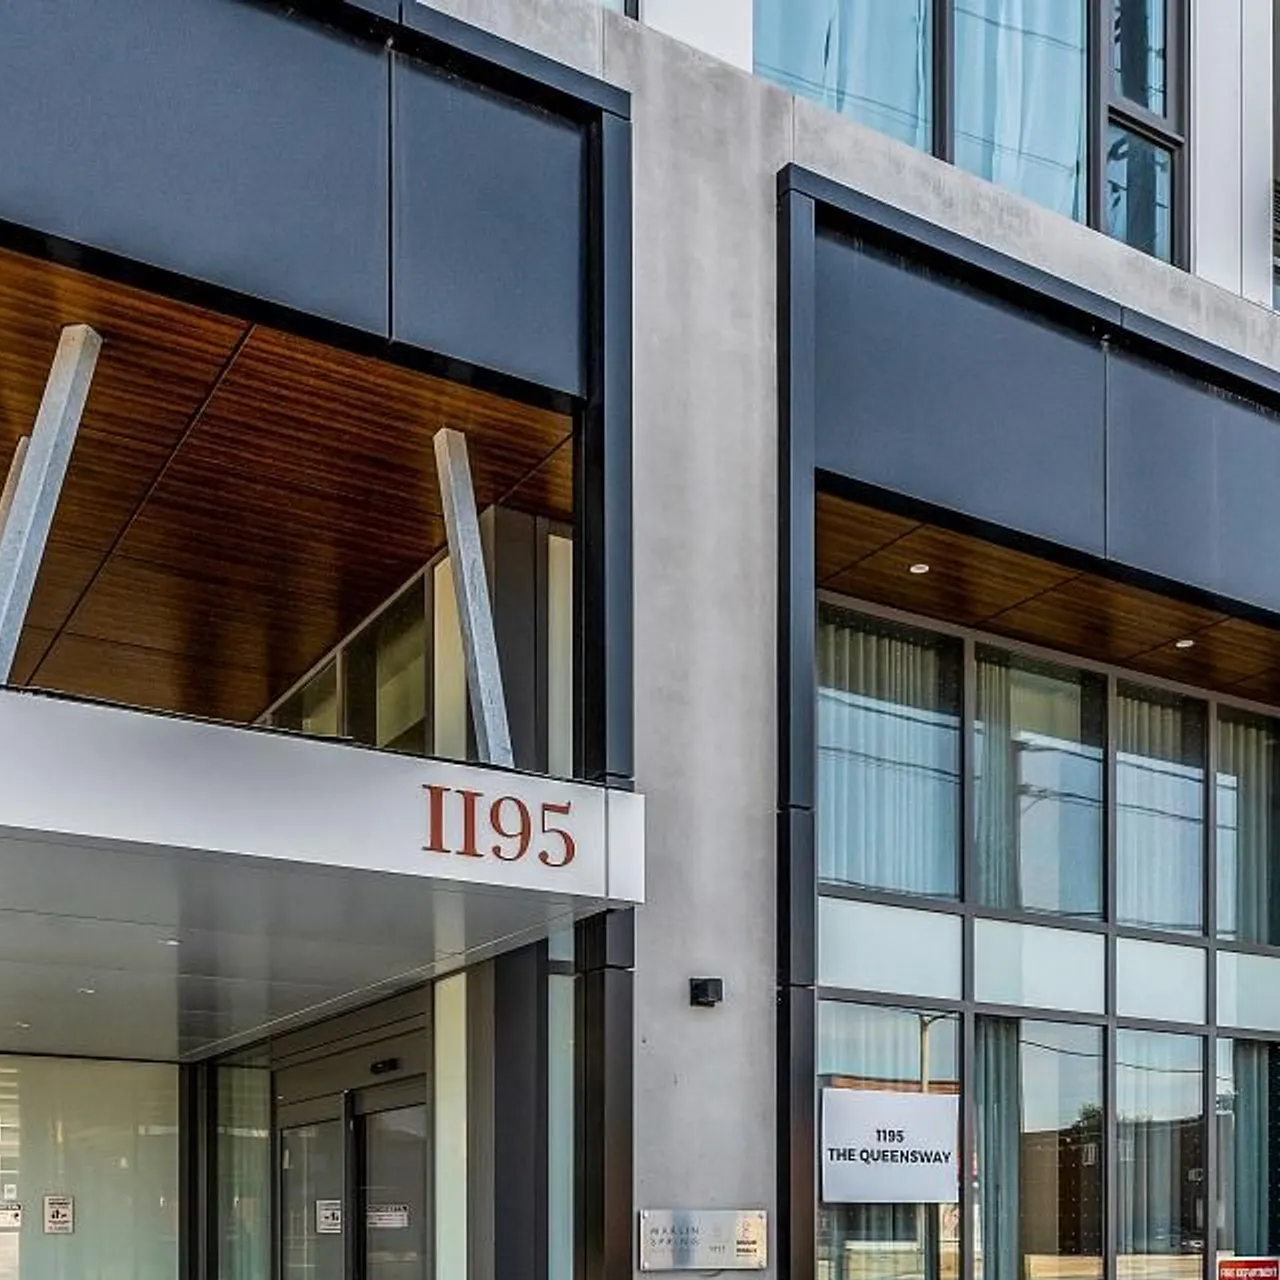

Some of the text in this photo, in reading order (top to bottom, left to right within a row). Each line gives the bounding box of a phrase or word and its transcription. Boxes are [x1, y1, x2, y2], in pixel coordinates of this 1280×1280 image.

[876, 1129, 905, 1143] 1195
[828, 1147, 951, 1165] THE QUEENSWAY
